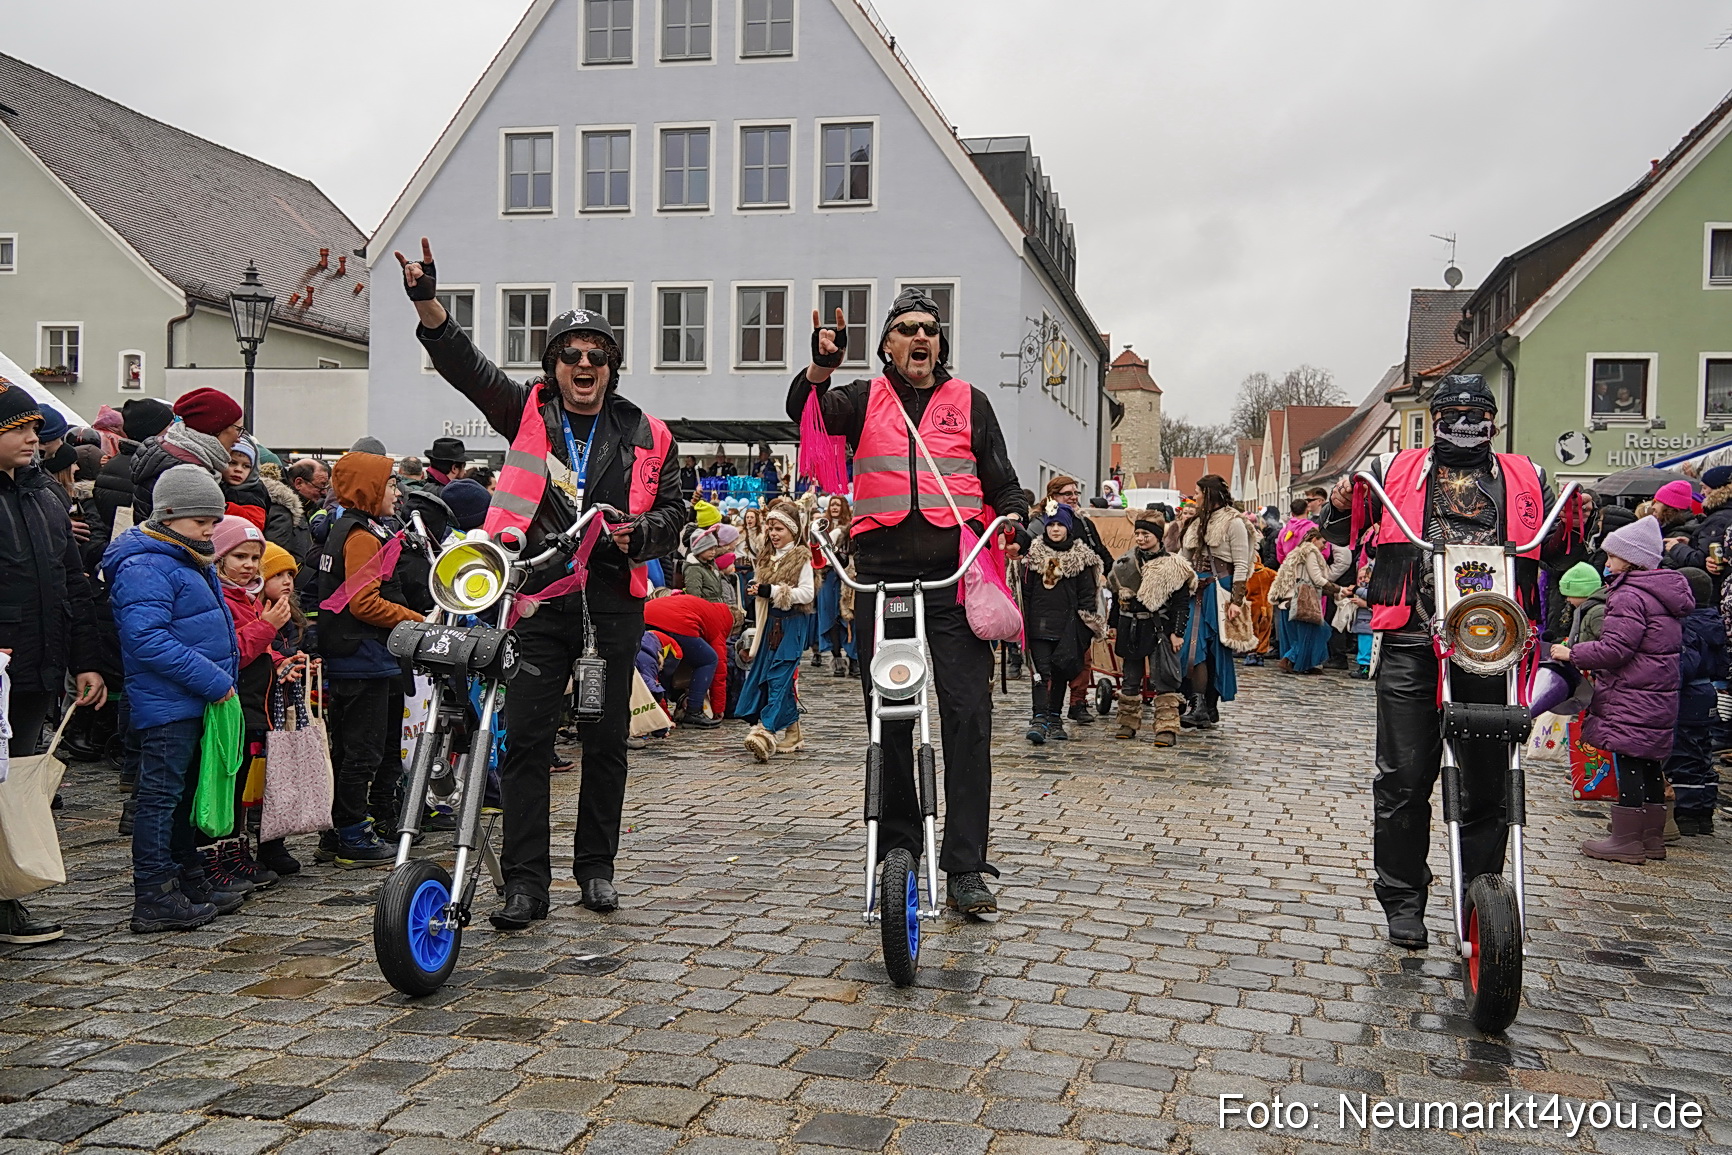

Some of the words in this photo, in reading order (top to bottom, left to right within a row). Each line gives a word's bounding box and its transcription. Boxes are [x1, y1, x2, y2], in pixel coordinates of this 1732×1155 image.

[442, 419, 498, 437] Raiffe
[1454, 560, 1496, 575] PUSSY
[890, 602, 909, 613] JBL
